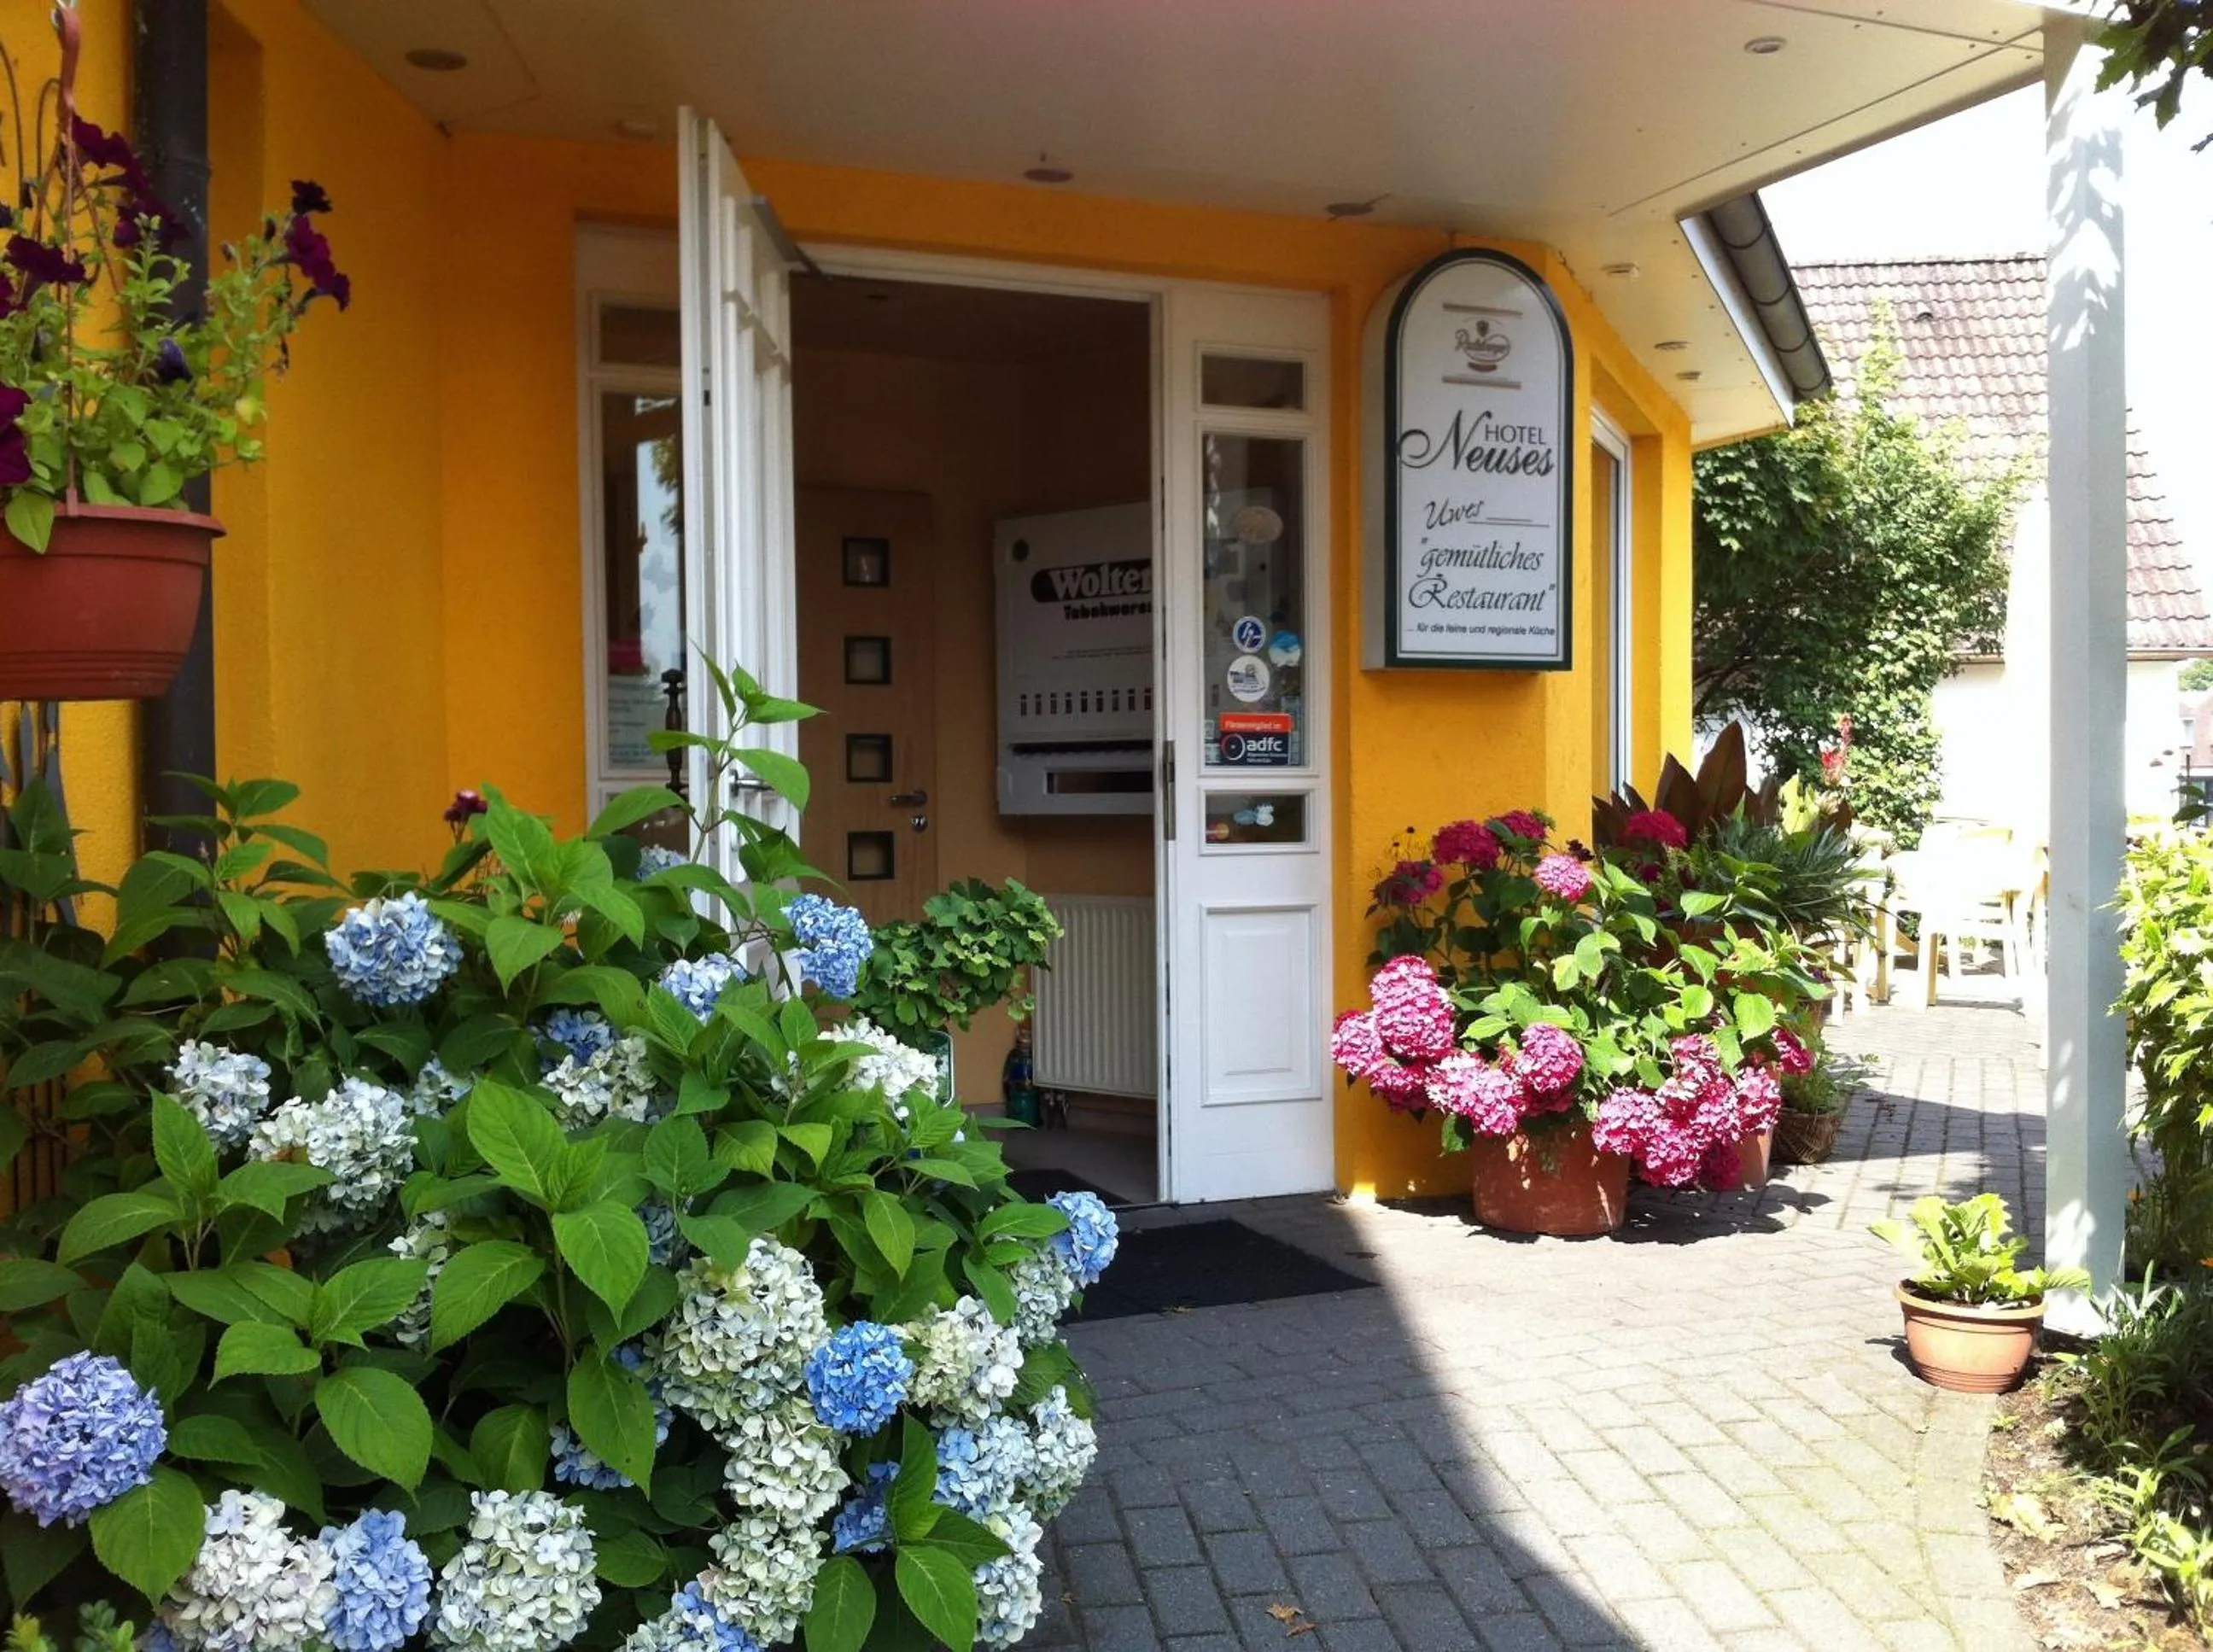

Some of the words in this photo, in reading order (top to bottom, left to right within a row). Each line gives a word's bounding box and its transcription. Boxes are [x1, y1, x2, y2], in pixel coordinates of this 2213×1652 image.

[1399, 409, 1554, 476] Neuses
[1484, 423, 1547, 446] HOTEL
[1424, 497, 1485, 530] Uwes
[1430, 623, 1445, 634] die
[1469, 624, 1486, 635] und
[1487, 625, 1527, 637] regionale
[1527, 625, 1556, 637] Küche
[1246, 737, 1283, 752] adfc
